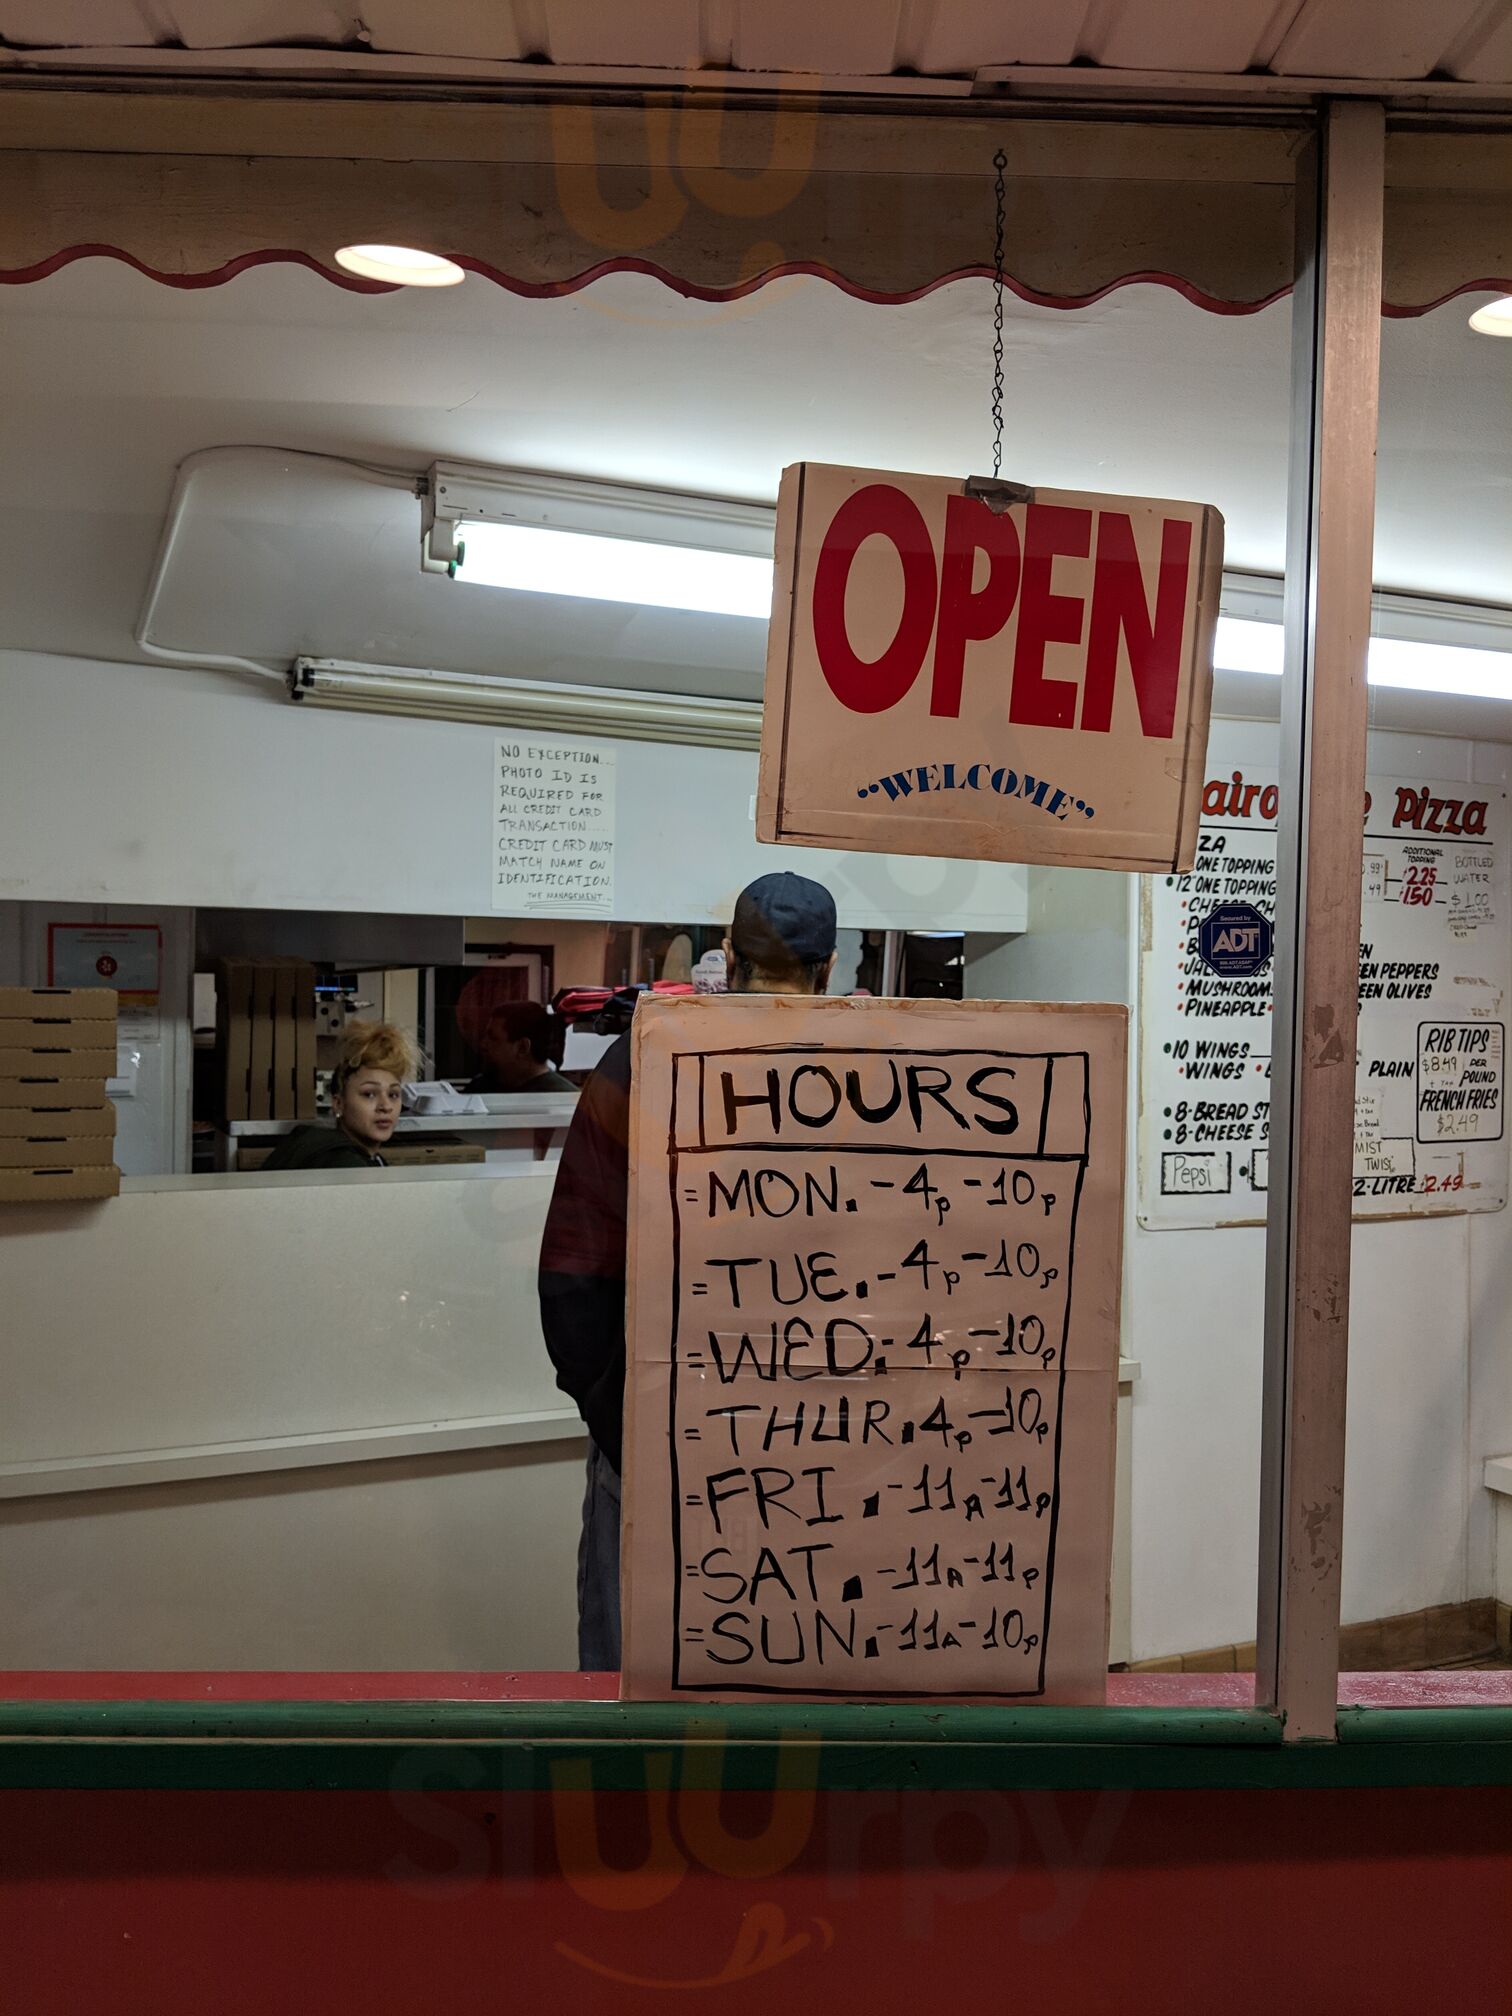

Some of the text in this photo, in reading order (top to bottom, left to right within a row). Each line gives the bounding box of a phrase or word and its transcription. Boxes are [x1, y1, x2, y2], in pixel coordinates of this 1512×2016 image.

[813, 484, 1192, 739] OPEN
[501, 745, 520, 758] NO
[501, 766, 597, 784] PHOTO ID IS
[500, 785, 603, 801] REQUIRED FOR
[500, 804, 602, 817] ALL CREDIT CARD
[1201, 771, 1279, 820] airo
[1392, 787, 1489, 835] Pizza
[499, 838, 613, 853] CREDIT CARD MUST
[1198, 835, 1226, 853] ZA
[1402, 846, 1444, 857] ADDITIONAL
[499, 856, 606, 870] MATCH NAME ON
[1195, 856, 1275, 874] ONE TOPPING
[1408, 855, 1436, 864] TOPPING
[1195, 876, 1221, 894] ONE
[1223, 878, 1277, 896] TOPPING
[1213, 928, 1260, 952] ADT
[1380, 962, 1440, 980] PEPPERS
[1185, 979, 1273, 998] MUSHROOM
[1386, 982, 1432, 1000] OLIVES
[1185, 998, 1266, 1018] PINEAPPLE
[1172, 1039, 1250, 1060] 10 WINGS
[1425, 1028, 1456, 1053] RIB
[1457, 1028, 1490, 1053] TIPS
[1186, 1062, 1245, 1080] WINGS
[1368, 1060, 1414, 1078] PLAIN
[1421, 1056, 1457, 1075] $8.49
[1469, 1058, 1487, 1067] PER
[1459, 1070, 1496, 1087] POUND
[721, 1059, 1019, 1134] HOURS
[1420, 1088, 1499, 1112] FRENCH FRIES
[1437, 1113, 1479, 1135] $2.49
[1173, 1155, 1211, 1189] Pepsi
